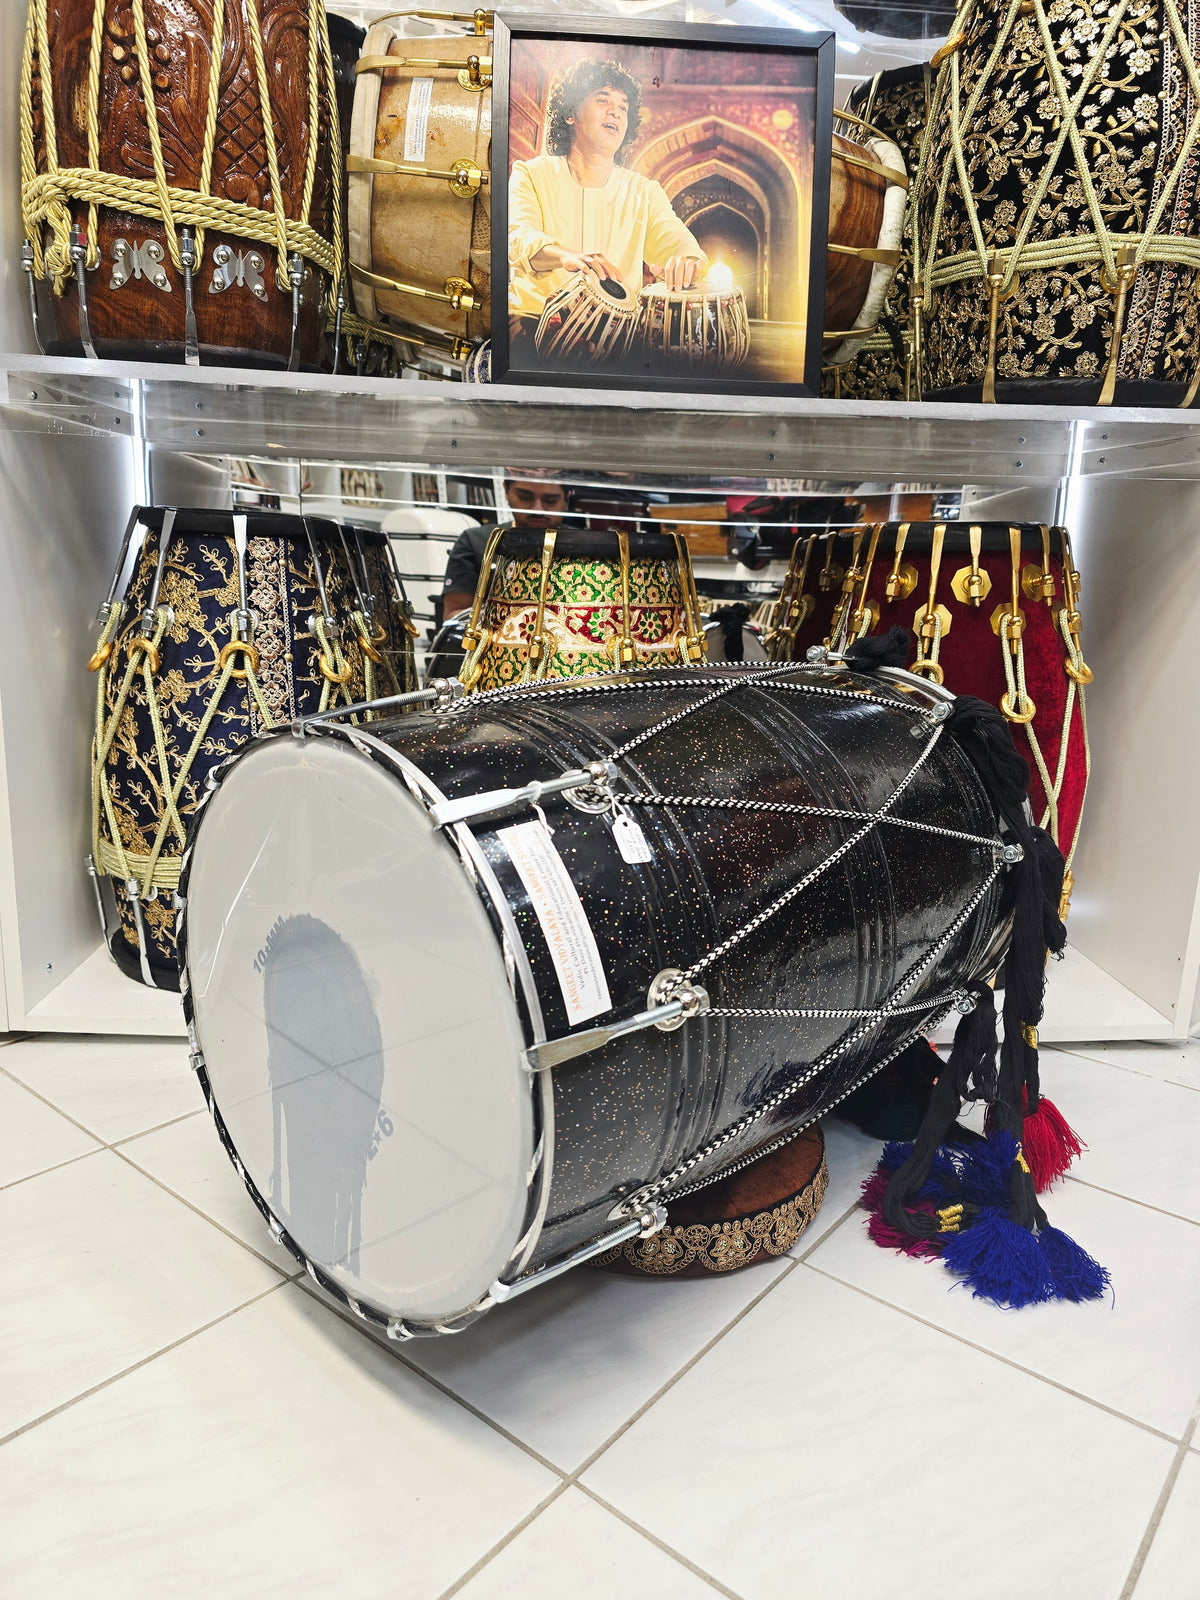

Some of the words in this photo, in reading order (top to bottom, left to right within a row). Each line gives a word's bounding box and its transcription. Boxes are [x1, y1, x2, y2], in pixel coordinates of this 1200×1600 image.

[521, 862, 545, 900] SANGEET
[545, 909, 569, 965] VIDYALAYA
[560, 921, 570, 935] and
[565, 936, 580, 968] Cultural
[562, 967, 582, 1011] SANGEET
[577, 969, 586, 990] Vedic
